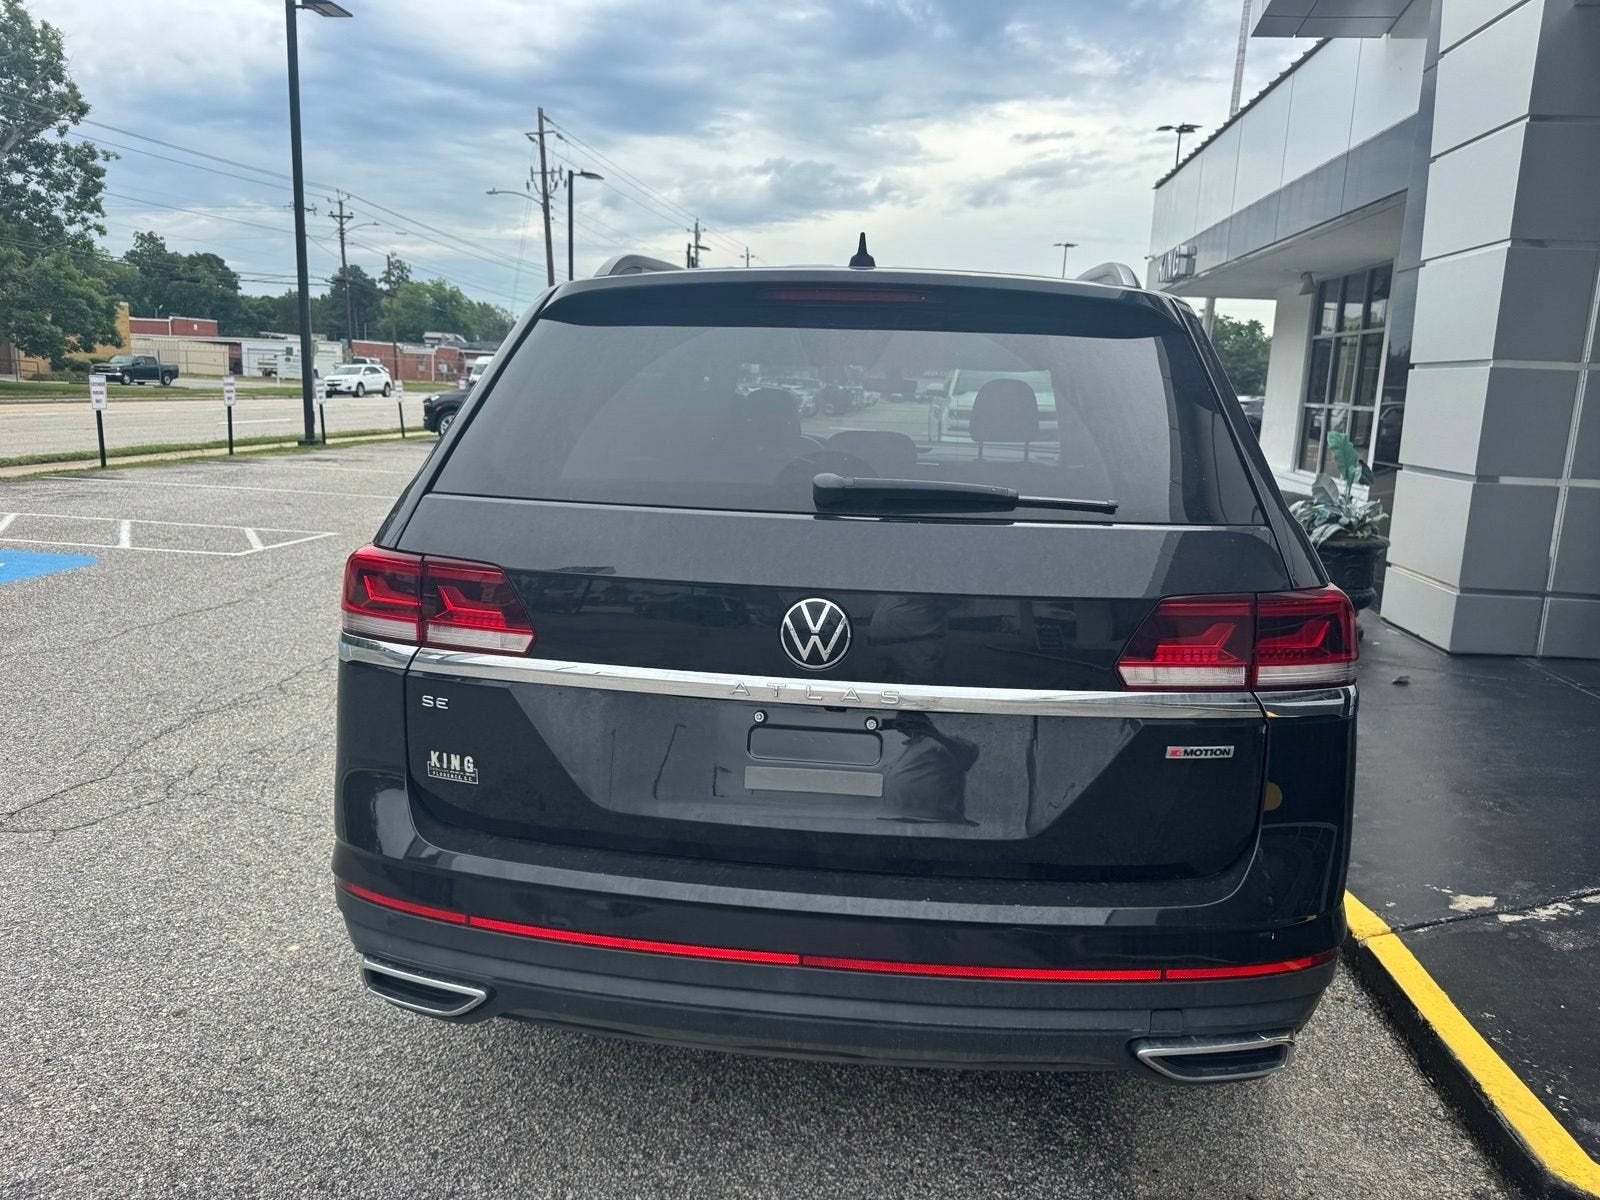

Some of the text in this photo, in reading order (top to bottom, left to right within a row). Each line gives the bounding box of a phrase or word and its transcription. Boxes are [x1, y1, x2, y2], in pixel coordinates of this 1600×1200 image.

[421, 694, 449, 710] SE
[730, 681, 900, 705] ATLAS
[430, 750, 474, 773] KING
